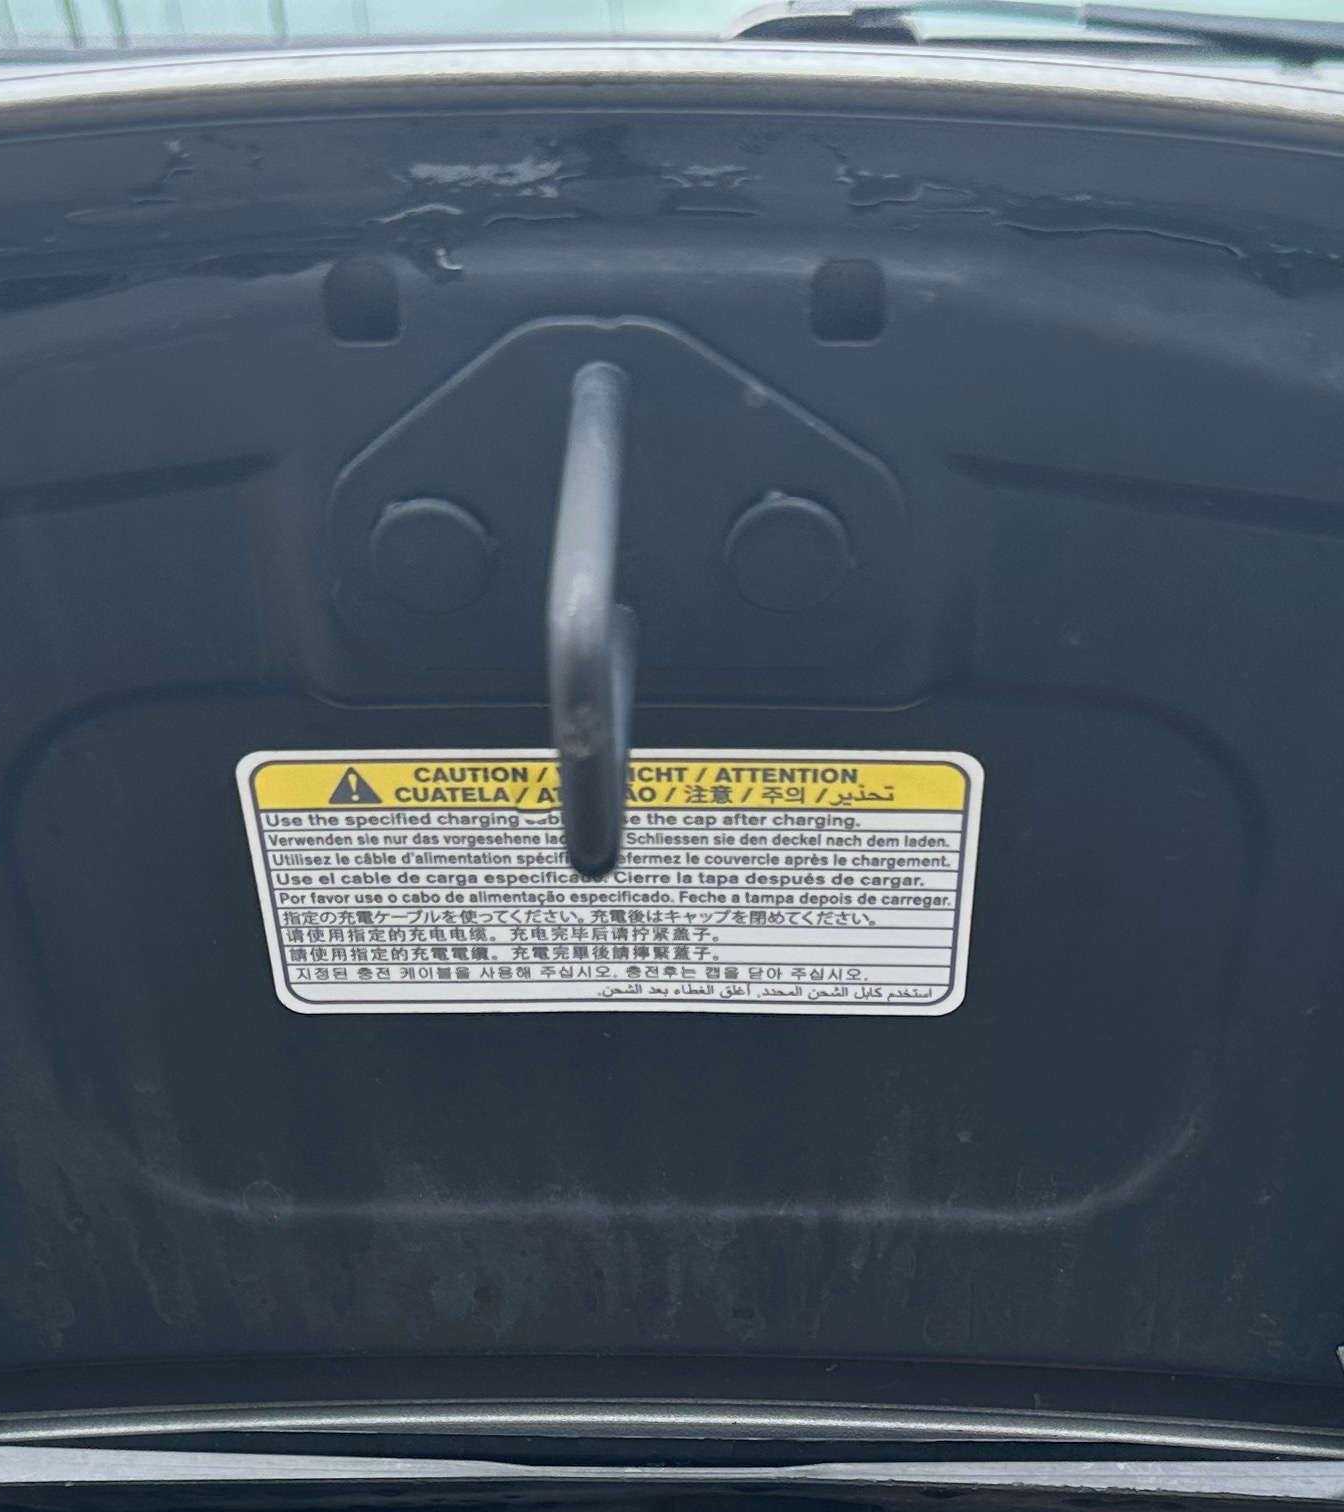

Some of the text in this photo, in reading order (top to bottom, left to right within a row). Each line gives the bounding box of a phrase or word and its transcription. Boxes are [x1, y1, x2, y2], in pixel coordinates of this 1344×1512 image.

[413, 767, 529, 784] CAUTION
[536, 768, 548, 784] /
[696, 767, 707, 785] /
[714, 767, 859, 785] ATTENTION
[394, 787, 511, 804] CUATELA
[515, 787, 529, 804] /
[665, 787, 677, 804] /
[684, 785, 734, 805] 注意
[741, 787, 753, 804] /
[761, 785, 806, 806] 주의
[815, 787, 828, 804] /
[829, 785, 895, 808] تحذير
[265, 813, 303, 828] Use
[308, 813, 339, 826] the
[344, 812, 432, 829] specified
[436, 812, 520, 829] charging
[646, 812, 677, 826] the
[682, 815, 717, 829] cap
[722, 812, 768, 826] after
[772, 813, 862, 830] charging.
[267, 833, 353, 847] Verwenden
[356, 833, 379, 846] sie
[383, 835, 408, 845] nur
[412, 832, 440, 845] das
[443, 835, 541, 848] vorgesehene
[626, 832, 709, 845] Schliessen
[713, 833, 736, 846] sie
[739, 833, 768, 846] den
[771, 833, 822, 846] deckel
[826, 834, 862, 847] nach
[866, 835, 900, 848] dem
[904, 835, 951, 848] laden.
[272, 853, 332, 867] Utilisez
[335, 852, 350, 866] le
[354, 852, 397, 866] câble
[401, 851, 512, 865] d'alimentation
[616, 852, 681, 865] efermez
[685, 852, 700, 865] le
[704, 852, 780, 866] couvercle
[784, 852, 829, 868] après
[833, 853, 847, 867] le
[851, 854, 951, 870] chargement.
[276, 873, 313, 887] Use
[318, 872, 335, 885] el
[340, 871, 392, 885] cable
[397, 871, 421, 885] de
[426, 874, 478, 888] carga
[614, 871, 671, 885] Cierre
[676, 871, 693, 885] la
[698, 872, 739, 887] tapa
[744, 871, 826, 888] después
[831, 873, 855, 887] de
[860, 876, 926, 890] cargar.
[279, 890, 951, 909] Por favor use o cabo de alimentação especificado. Feche a tampa depois de carregar.
[296, 966, 349, 981] 지정된
[357, 966, 391, 980] 충전
[400, 966, 471, 980] 케이블을
[480, 966, 532, 980] 사용해
[541, 965, 617, 980] 주십시오.
[705, 966, 740, 980] 캡을
[748, 967, 782, 981] 닫아
[791, 968, 869, 982] 주십시오.
